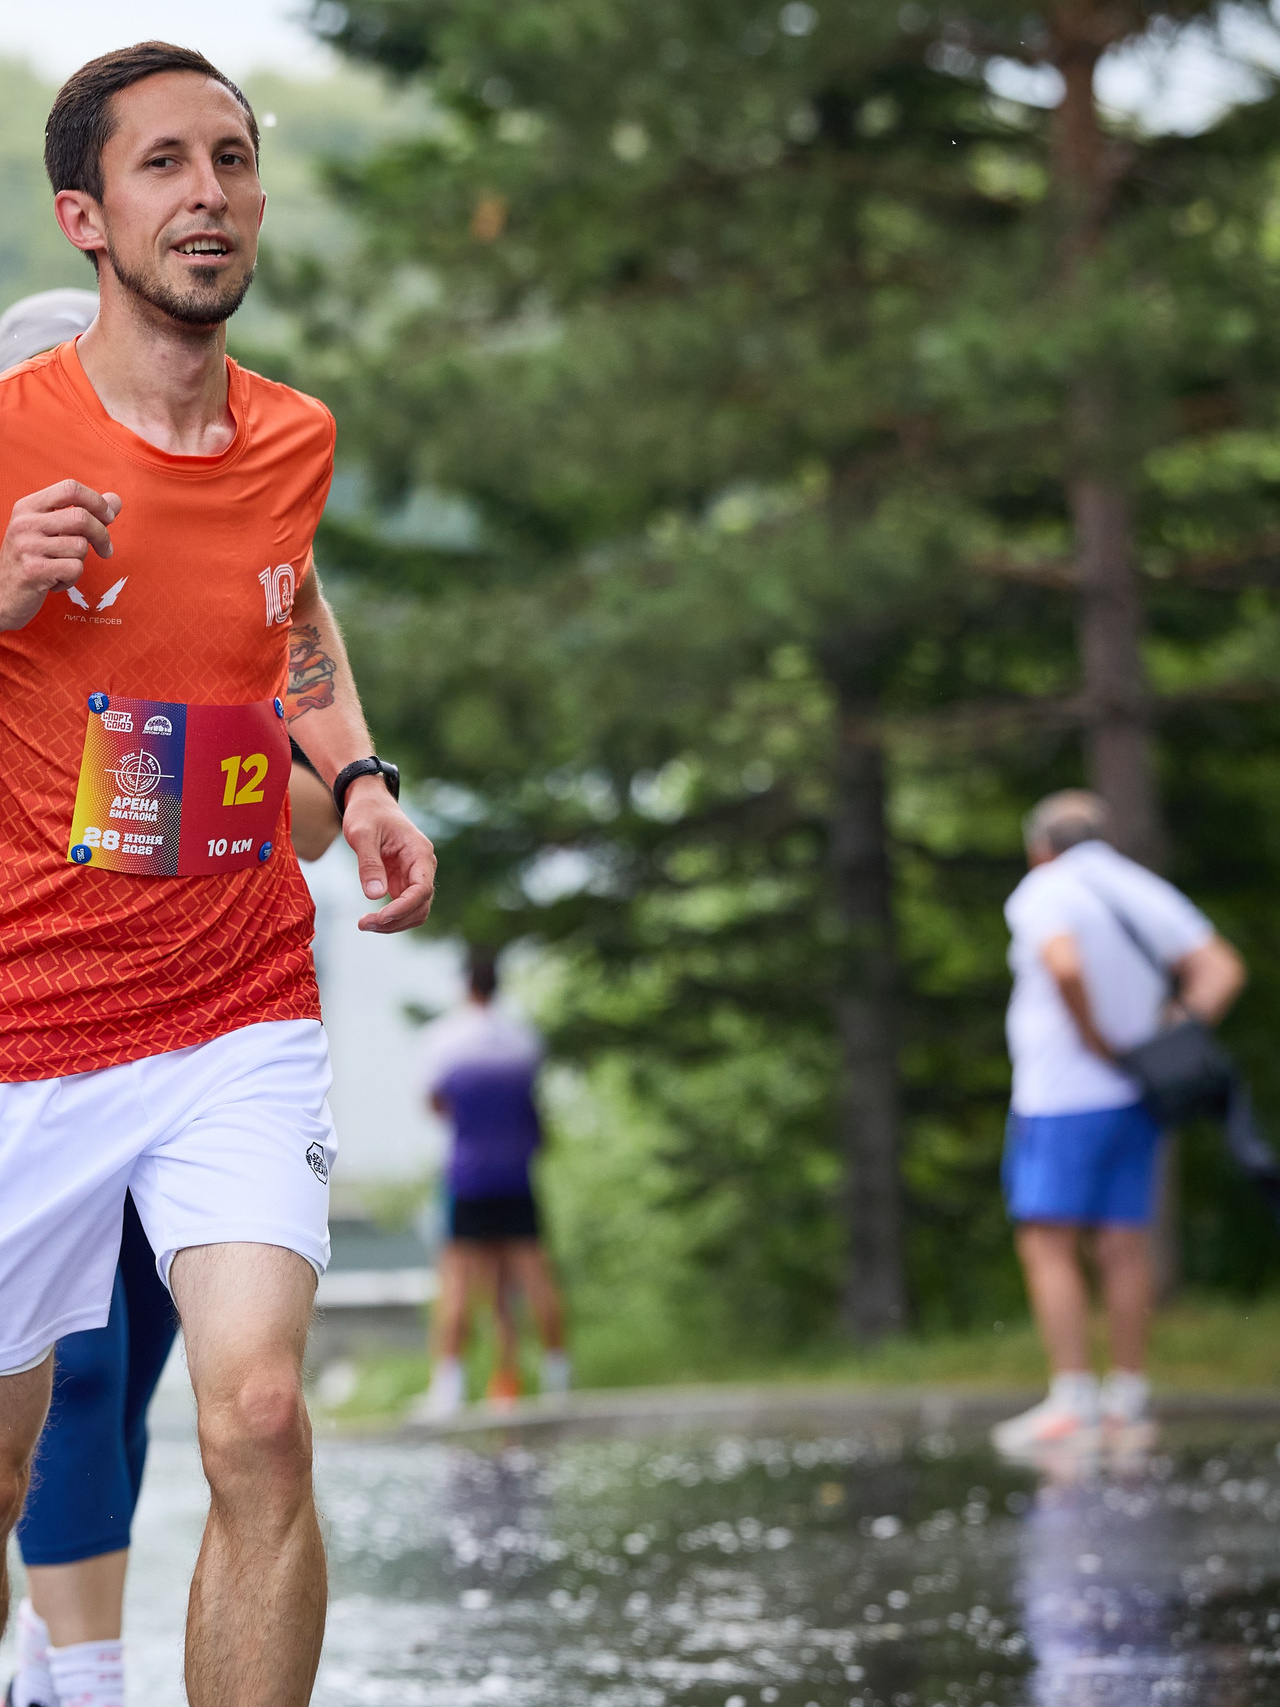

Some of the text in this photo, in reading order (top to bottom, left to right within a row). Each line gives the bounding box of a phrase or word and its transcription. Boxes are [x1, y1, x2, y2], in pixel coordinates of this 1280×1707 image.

[258, 563, 295, 627] 10
[64, 614, 122, 625] ЛИГА ГЕРОЕВ
[107, 721, 132, 731] СОЮЗ
[221, 753, 268, 806] 12
[111, 796, 158, 812] АРЕНА
[109, 809, 158, 821] БИАТЛОНА
[83, 826, 120, 850] 28
[123, 832, 163, 845] ИЮНЯ
[121, 844, 153, 855] 2026
[207, 838, 227, 857] 10
